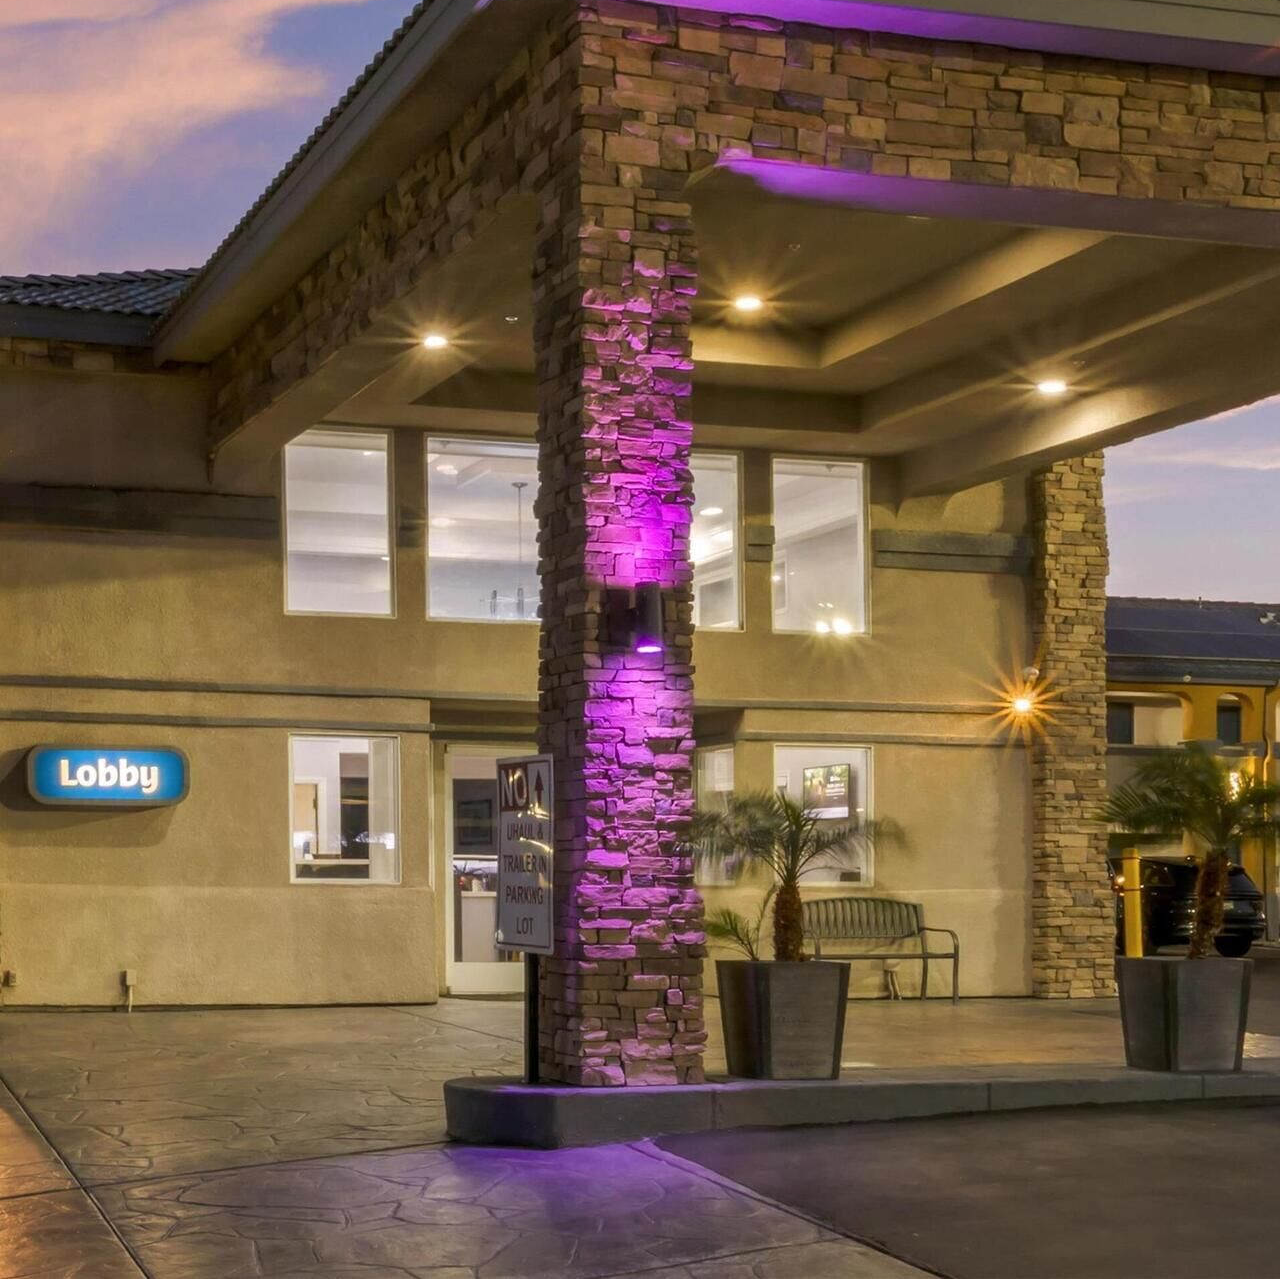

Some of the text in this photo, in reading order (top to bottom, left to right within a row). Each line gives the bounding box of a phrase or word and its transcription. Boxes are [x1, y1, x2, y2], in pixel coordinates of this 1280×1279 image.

[60, 758, 160, 794] Lobby
[501, 768, 527, 807] NO
[507, 822, 533, 840] UHAUL
[503, 854, 537, 873] TRAILER
[505, 885, 544, 905] PARKING
[516, 917, 534, 935] LOT
